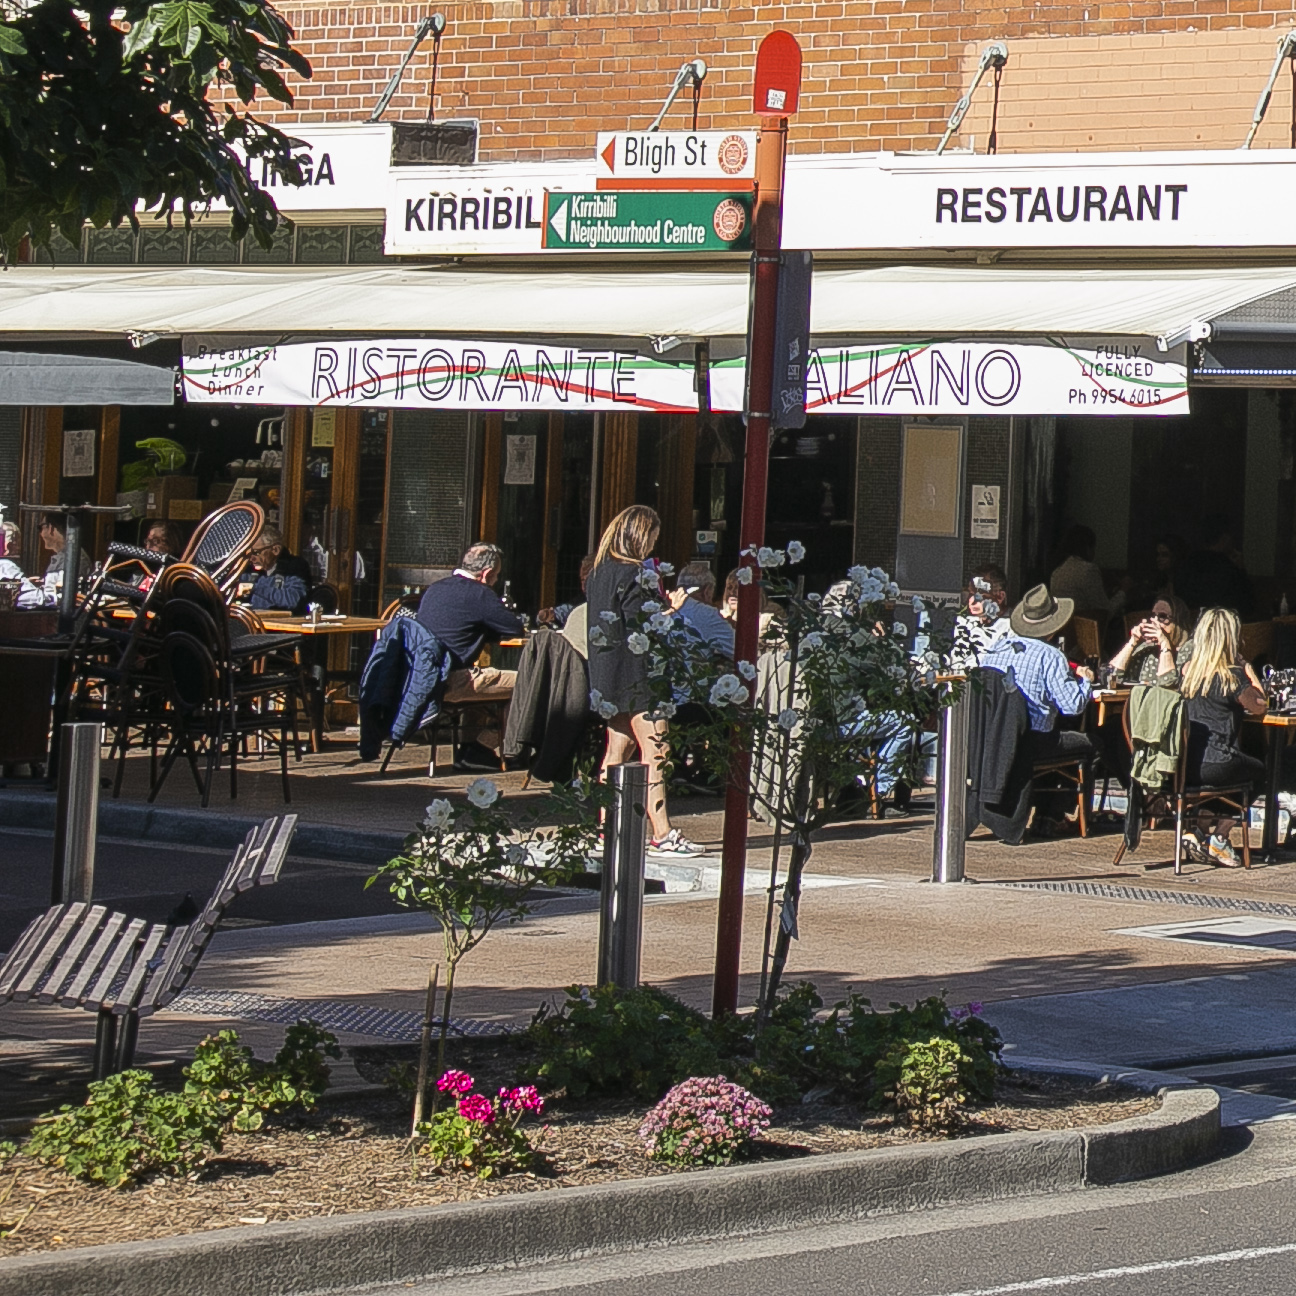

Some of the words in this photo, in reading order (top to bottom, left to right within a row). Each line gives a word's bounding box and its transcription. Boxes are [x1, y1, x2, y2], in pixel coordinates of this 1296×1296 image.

[624, 136, 676, 175] Bligh
[685, 136, 708, 167] St
[571, 195, 617, 218] Kirribilli
[936, 184, 1188, 223] RESTAURANT
[570, 220, 661, 248] Neighbourhood
[664, 220, 706, 244] Centre
[197, 344, 277, 362] Breakfast
[1095, 345, 1142, 360] FULLY
[211, 363, 262, 379] Lunch
[311, 346, 637, 404] RISTORANTE
[1081, 362, 1154, 378] LICENCED
[207, 380, 265, 397] Dinner
[1068, 388, 1087, 404] Ph
[1091, 388, 1126, 405] 9954
[1129, 388, 1162, 405] 6015
